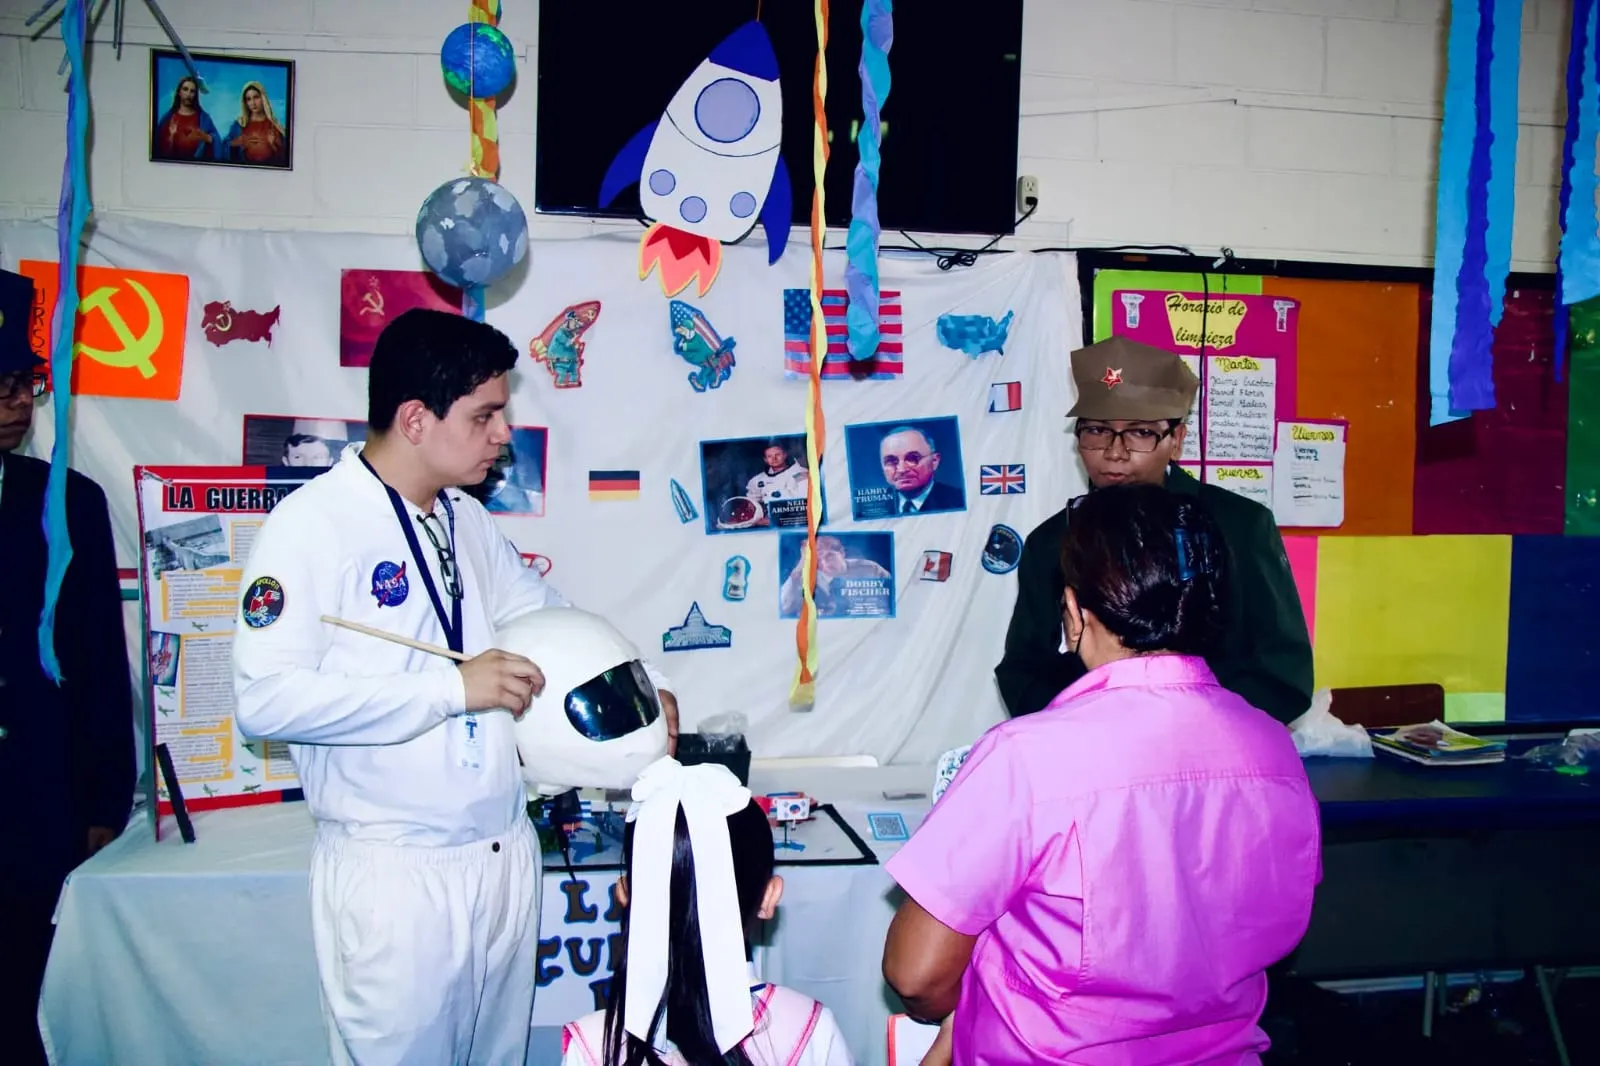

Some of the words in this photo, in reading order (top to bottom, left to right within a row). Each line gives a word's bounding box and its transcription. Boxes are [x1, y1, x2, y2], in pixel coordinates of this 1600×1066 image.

[1166, 294, 1222, 315] Horario
[1228, 300, 1245, 316] de
[32, 287, 46, 356] URS
[1175, 327, 1234, 348] limpieza
[168, 486, 195, 510] LA
[855, 494, 894, 503] TRUMAN
[857, 487, 888, 496] HARRY
[375, 576, 406, 591] NASA
[846, 580, 884, 588] BOBBY
[841, 588, 890, 597] FISCHER
